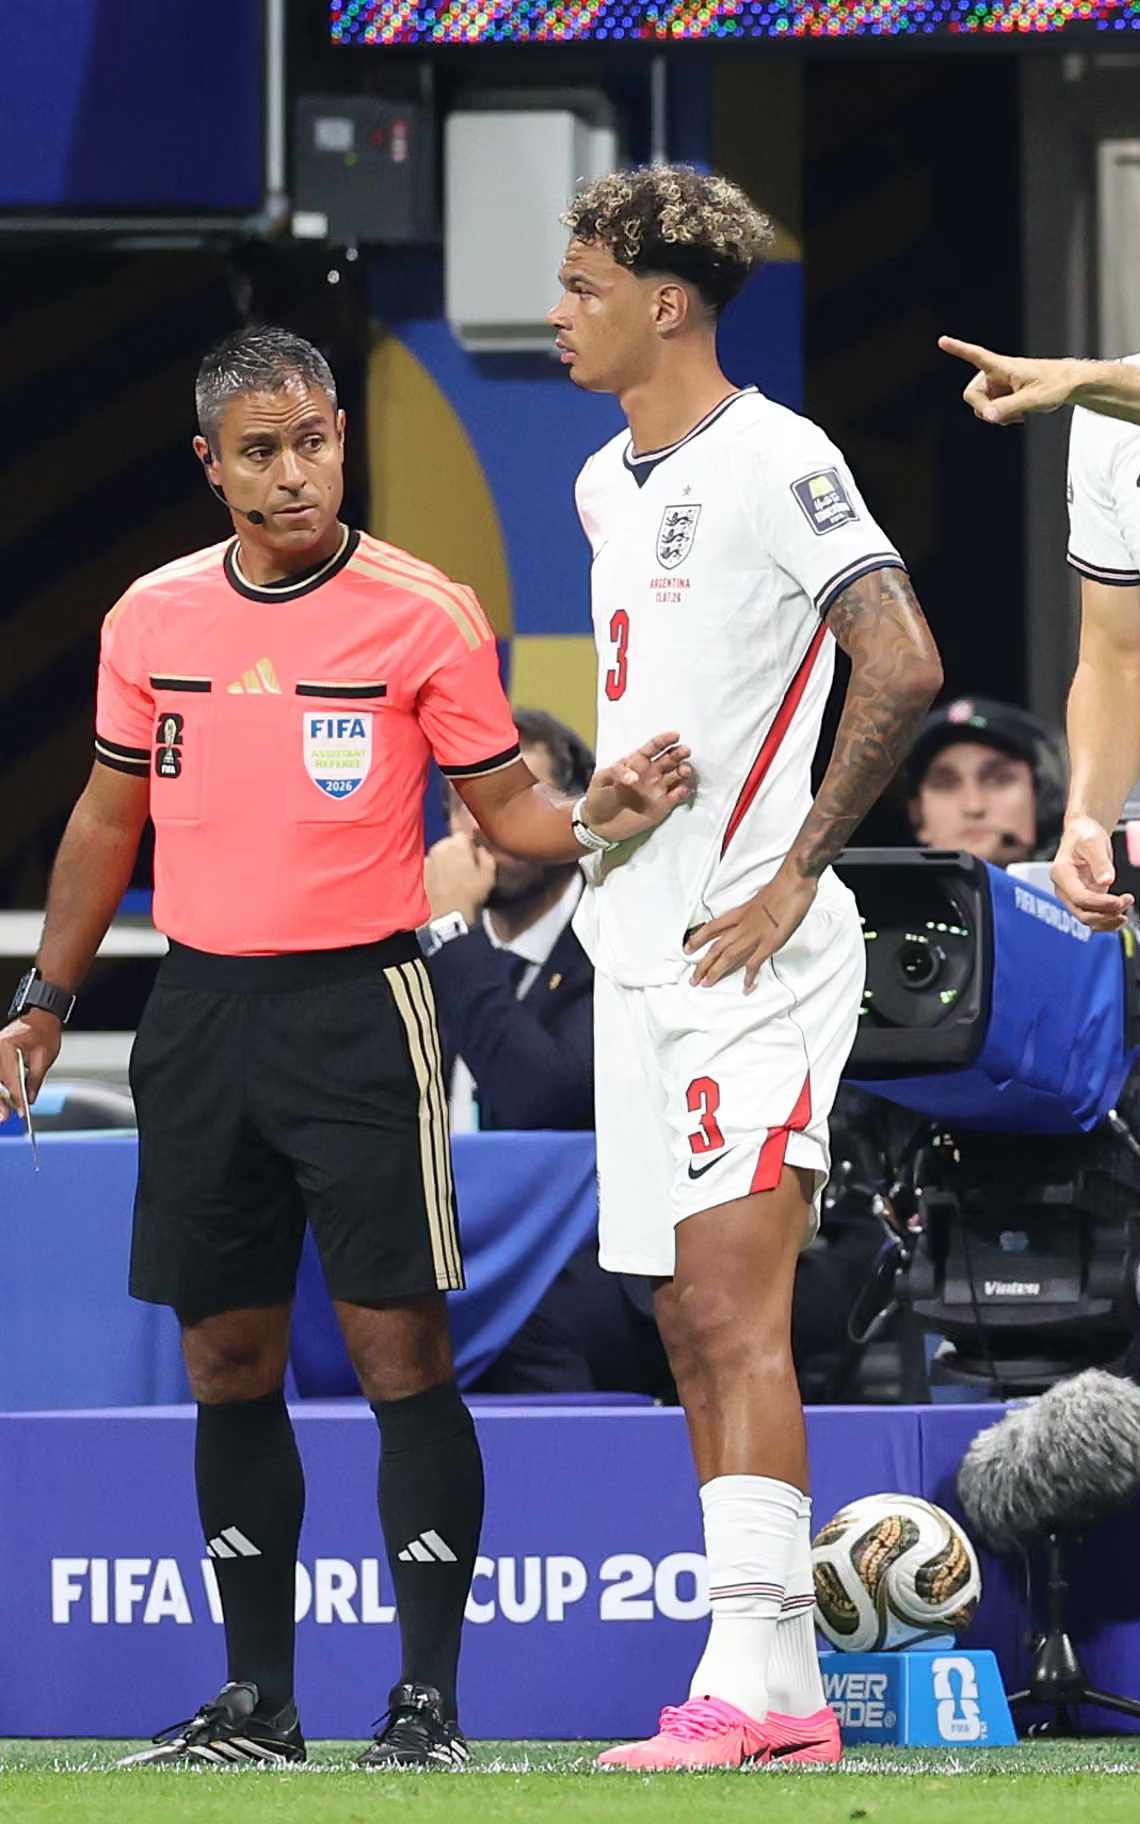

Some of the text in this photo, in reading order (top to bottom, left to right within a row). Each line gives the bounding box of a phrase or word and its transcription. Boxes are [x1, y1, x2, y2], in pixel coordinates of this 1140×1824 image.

[605, 609, 629, 701] 3
[311, 718, 366, 738] FIFA
[325, 781, 353, 792] 2026
[685, 1076, 725, 1154] 3
[51, 1558, 193, 1624] FIFA
[464, 1555, 588, 1623] CUP
[823, 1673, 888, 1700] WER
